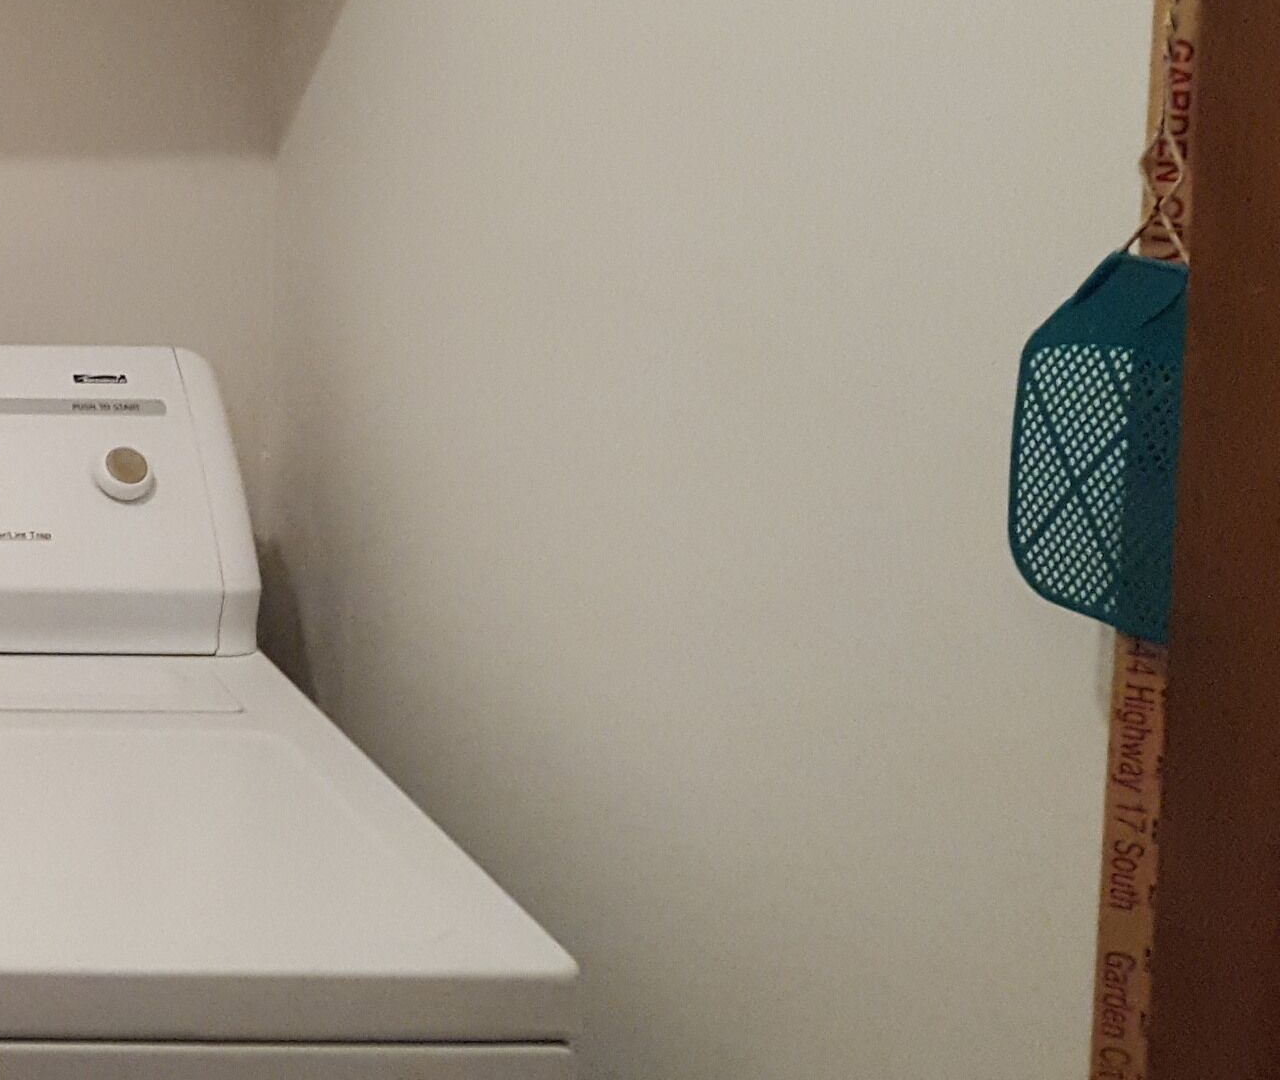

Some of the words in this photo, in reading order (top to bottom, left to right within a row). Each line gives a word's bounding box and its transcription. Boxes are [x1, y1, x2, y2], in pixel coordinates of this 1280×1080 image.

[1112, 683, 1155, 793] Highway
[1115, 804, 1148, 834] 17
[1109, 838, 1145, 911] South
[1101, 950, 1137, 1040] Garden
